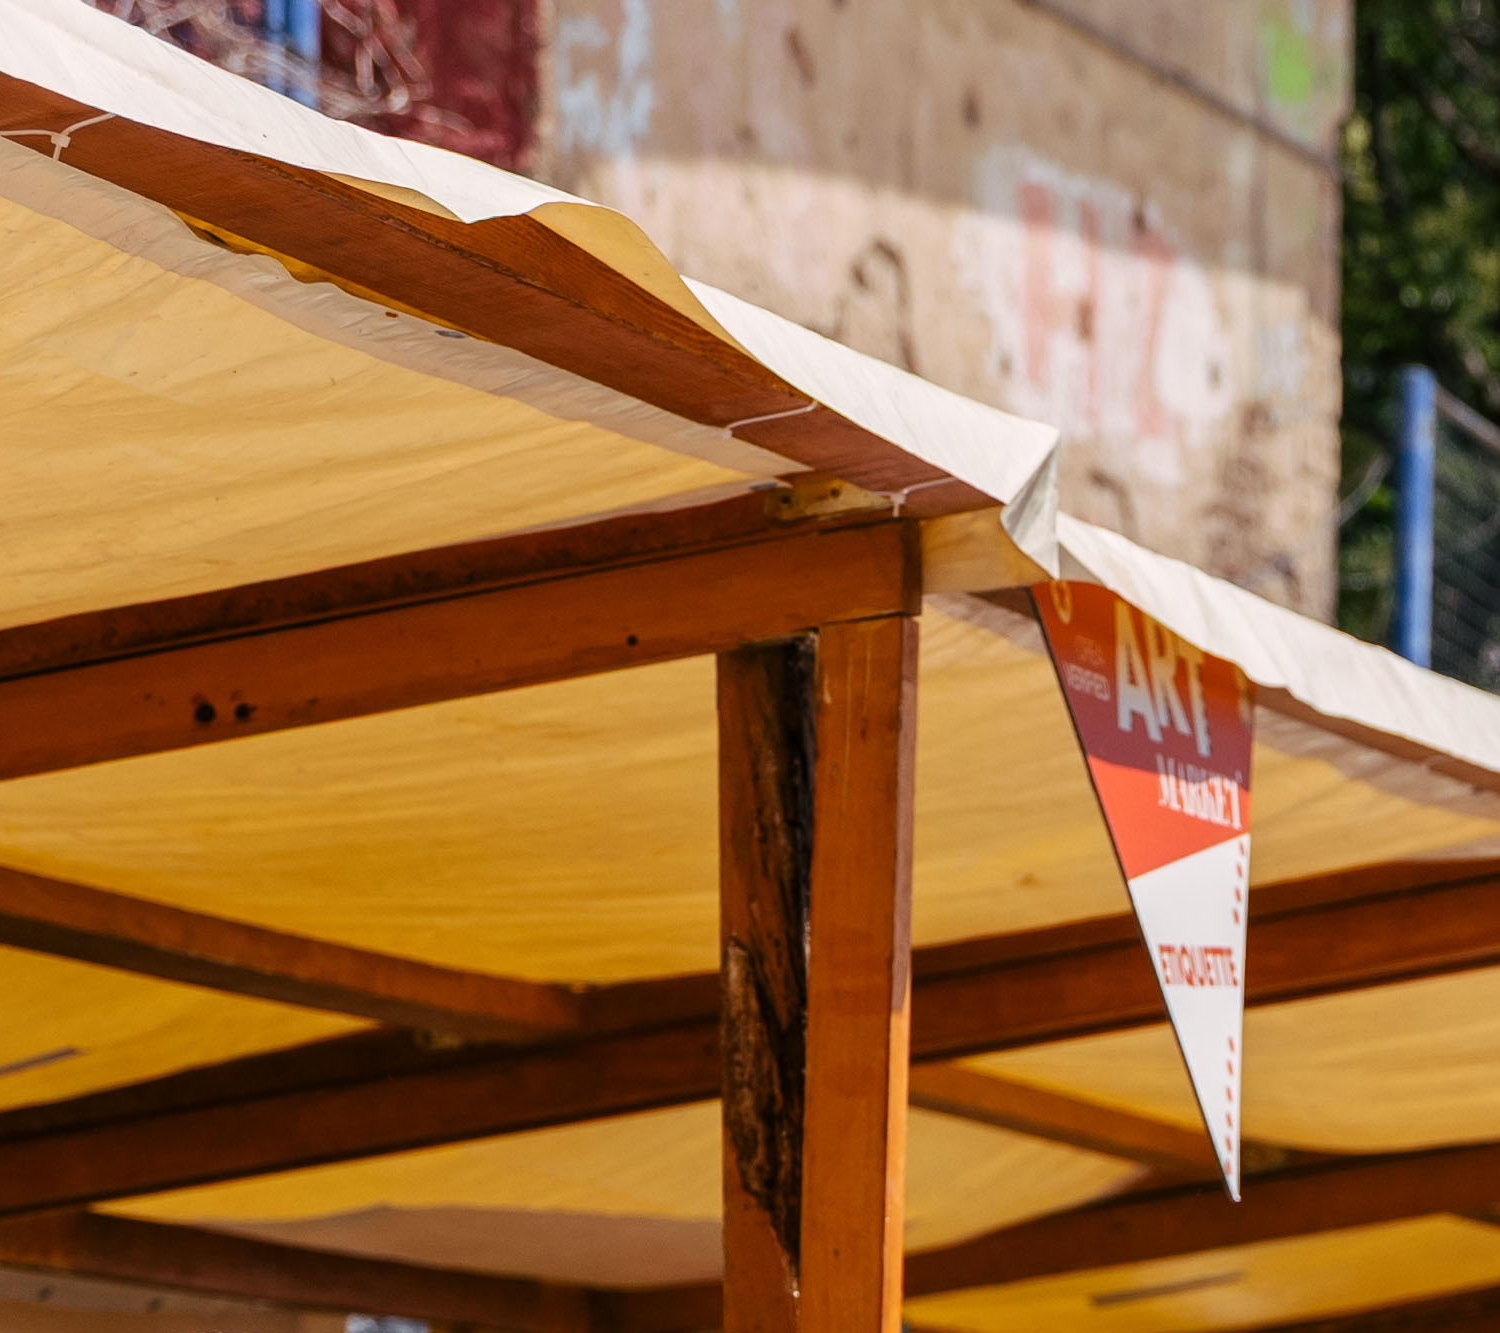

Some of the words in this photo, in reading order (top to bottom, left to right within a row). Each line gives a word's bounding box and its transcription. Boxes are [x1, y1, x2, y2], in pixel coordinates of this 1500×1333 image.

[1114, 598, 1211, 759] ART
[1155, 753, 1242, 831] MARKET
[1158, 943, 1238, 988] ETIQUETTE
